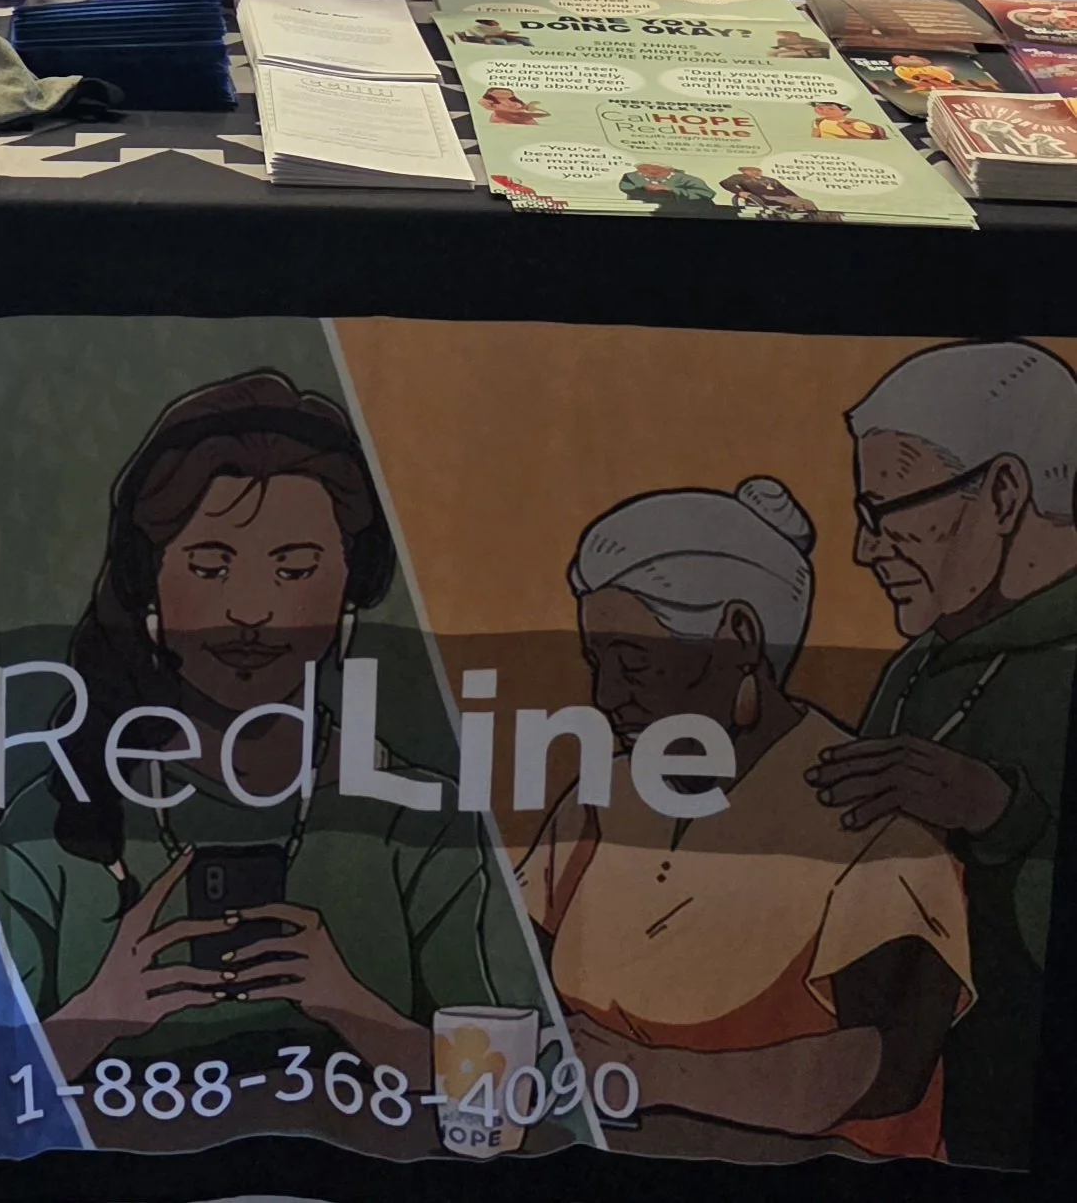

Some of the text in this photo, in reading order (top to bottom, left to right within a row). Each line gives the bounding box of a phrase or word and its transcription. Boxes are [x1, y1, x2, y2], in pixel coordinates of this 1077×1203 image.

[558, 16, 707, 28] ARE YOU
[520, 20, 752, 38] DOING OKAY?
[575, 45, 634, 53] OTHERS
[642, 42, 698, 50] THINGS
[583, 52, 636, 60] YOU'RE
[678, 56, 727, 64] DOING
[523, 62, 578, 70] haven't
[546, 76, 583, 84] have
[578, 72, 625, 80] lately,
[677, 76, 742, 84] sleeping
[488, 81, 539, 89] asking
[765, 86, 838, 96] spending
[646, 104, 689, 112] TALK
[655, 101, 733, 109] SOMEONE
[601, 111, 755, 127] CalHOPE
[615, 122, 752, 138] RedLine
[794, 158, 856, 166] haven't
[820, 165, 885, 174] looking
[805, 170, 845, 178] your
[834, 177, 900, 186] worries
[9, 1043, 641, 1128] 1-888-368-4090
